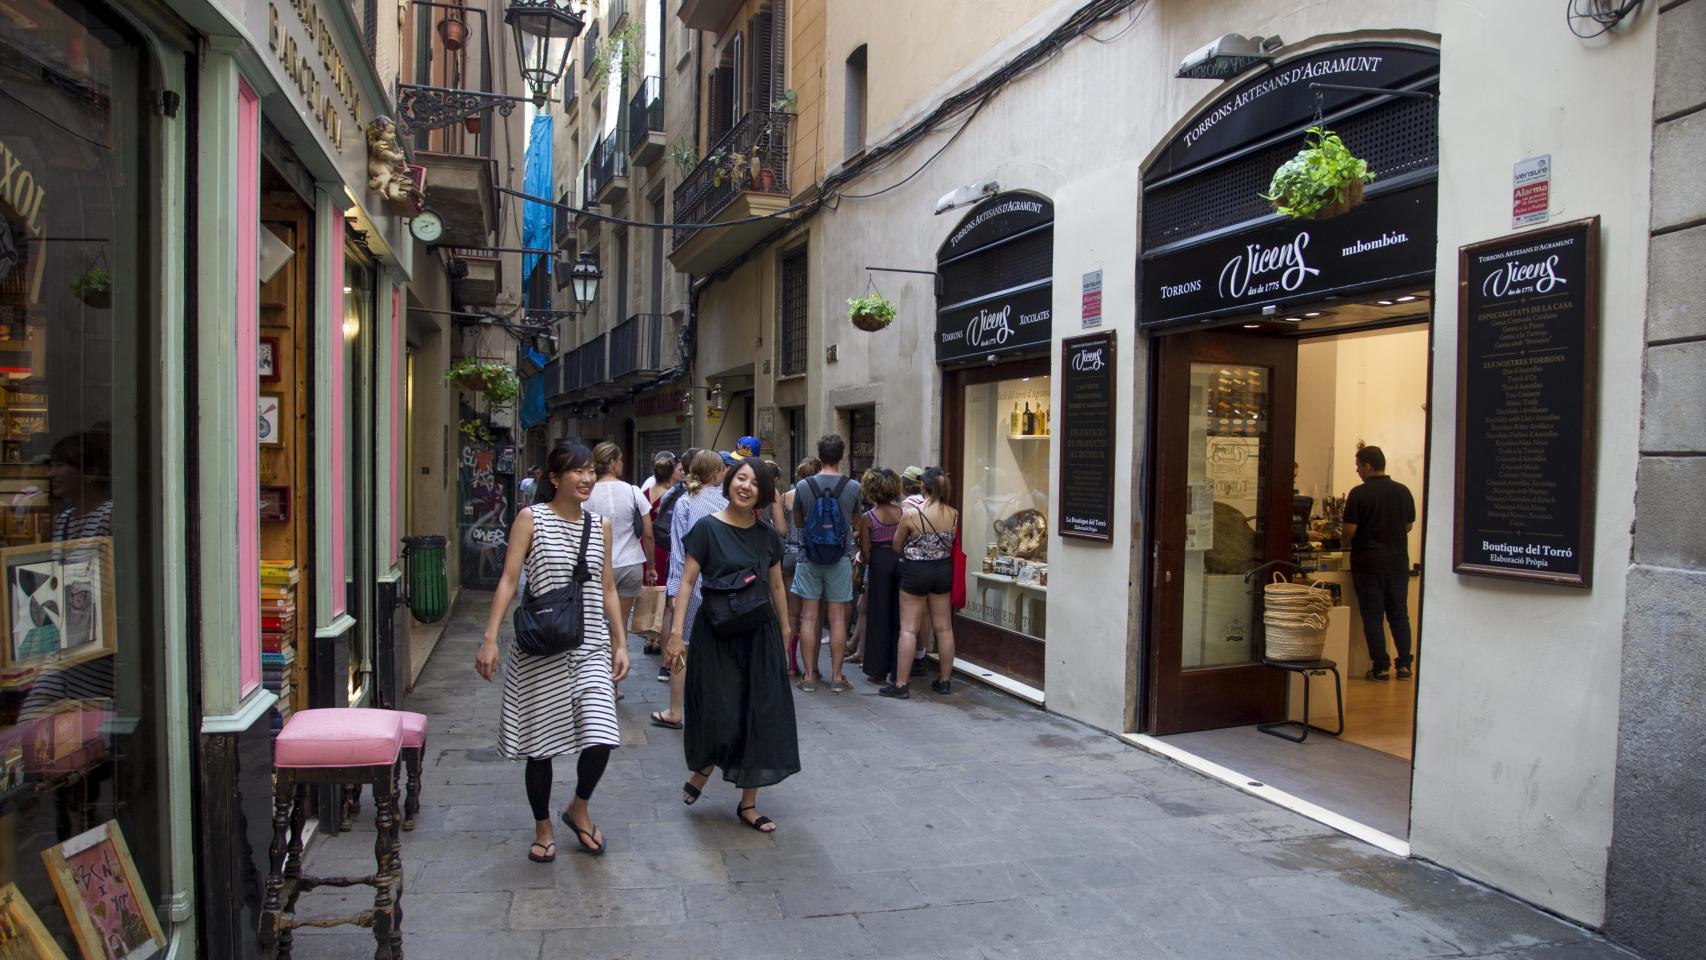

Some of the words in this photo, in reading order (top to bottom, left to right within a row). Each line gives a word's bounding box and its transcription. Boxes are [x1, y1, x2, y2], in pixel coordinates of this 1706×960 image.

[1183, 103, 1233, 149] TORRONS
[1233, 74, 1290, 111] ARTESANS
[1291, 57, 1382, 84] D'AGRAMUNT
[1514, 184, 1548, 197] Alarma
[951, 219, 976, 247] TORRONS
[975, 205, 1006, 226] ARTESANS
[1002, 201, 1043, 214] D'AGRAMUNT
[1478, 253, 1505, 264] TORRONS
[1505, 246, 1534, 258] ARTESANS
[1533, 238, 1575, 252] D'AGRAMUNT
[1218, 232, 1320, 298] Vicens
[1483, 254, 1567, 297] Vicens
[1160, 279, 1201, 299] TORRONS
[1264, 280, 1280, 292] 1775
[941, 330, 964, 343] TORRONS
[966, 304, 1015, 346] Vicens
[1019, 310, 1050, 325] XOCOLATES
[1482, 541, 1525, 555] Boutique
[1526, 545, 1540, 555] del
[1543, 546, 1573, 558] Torró
[1490, 554, 1525, 565] Elaboració
[1525, 556, 1549, 568] Pròpia
